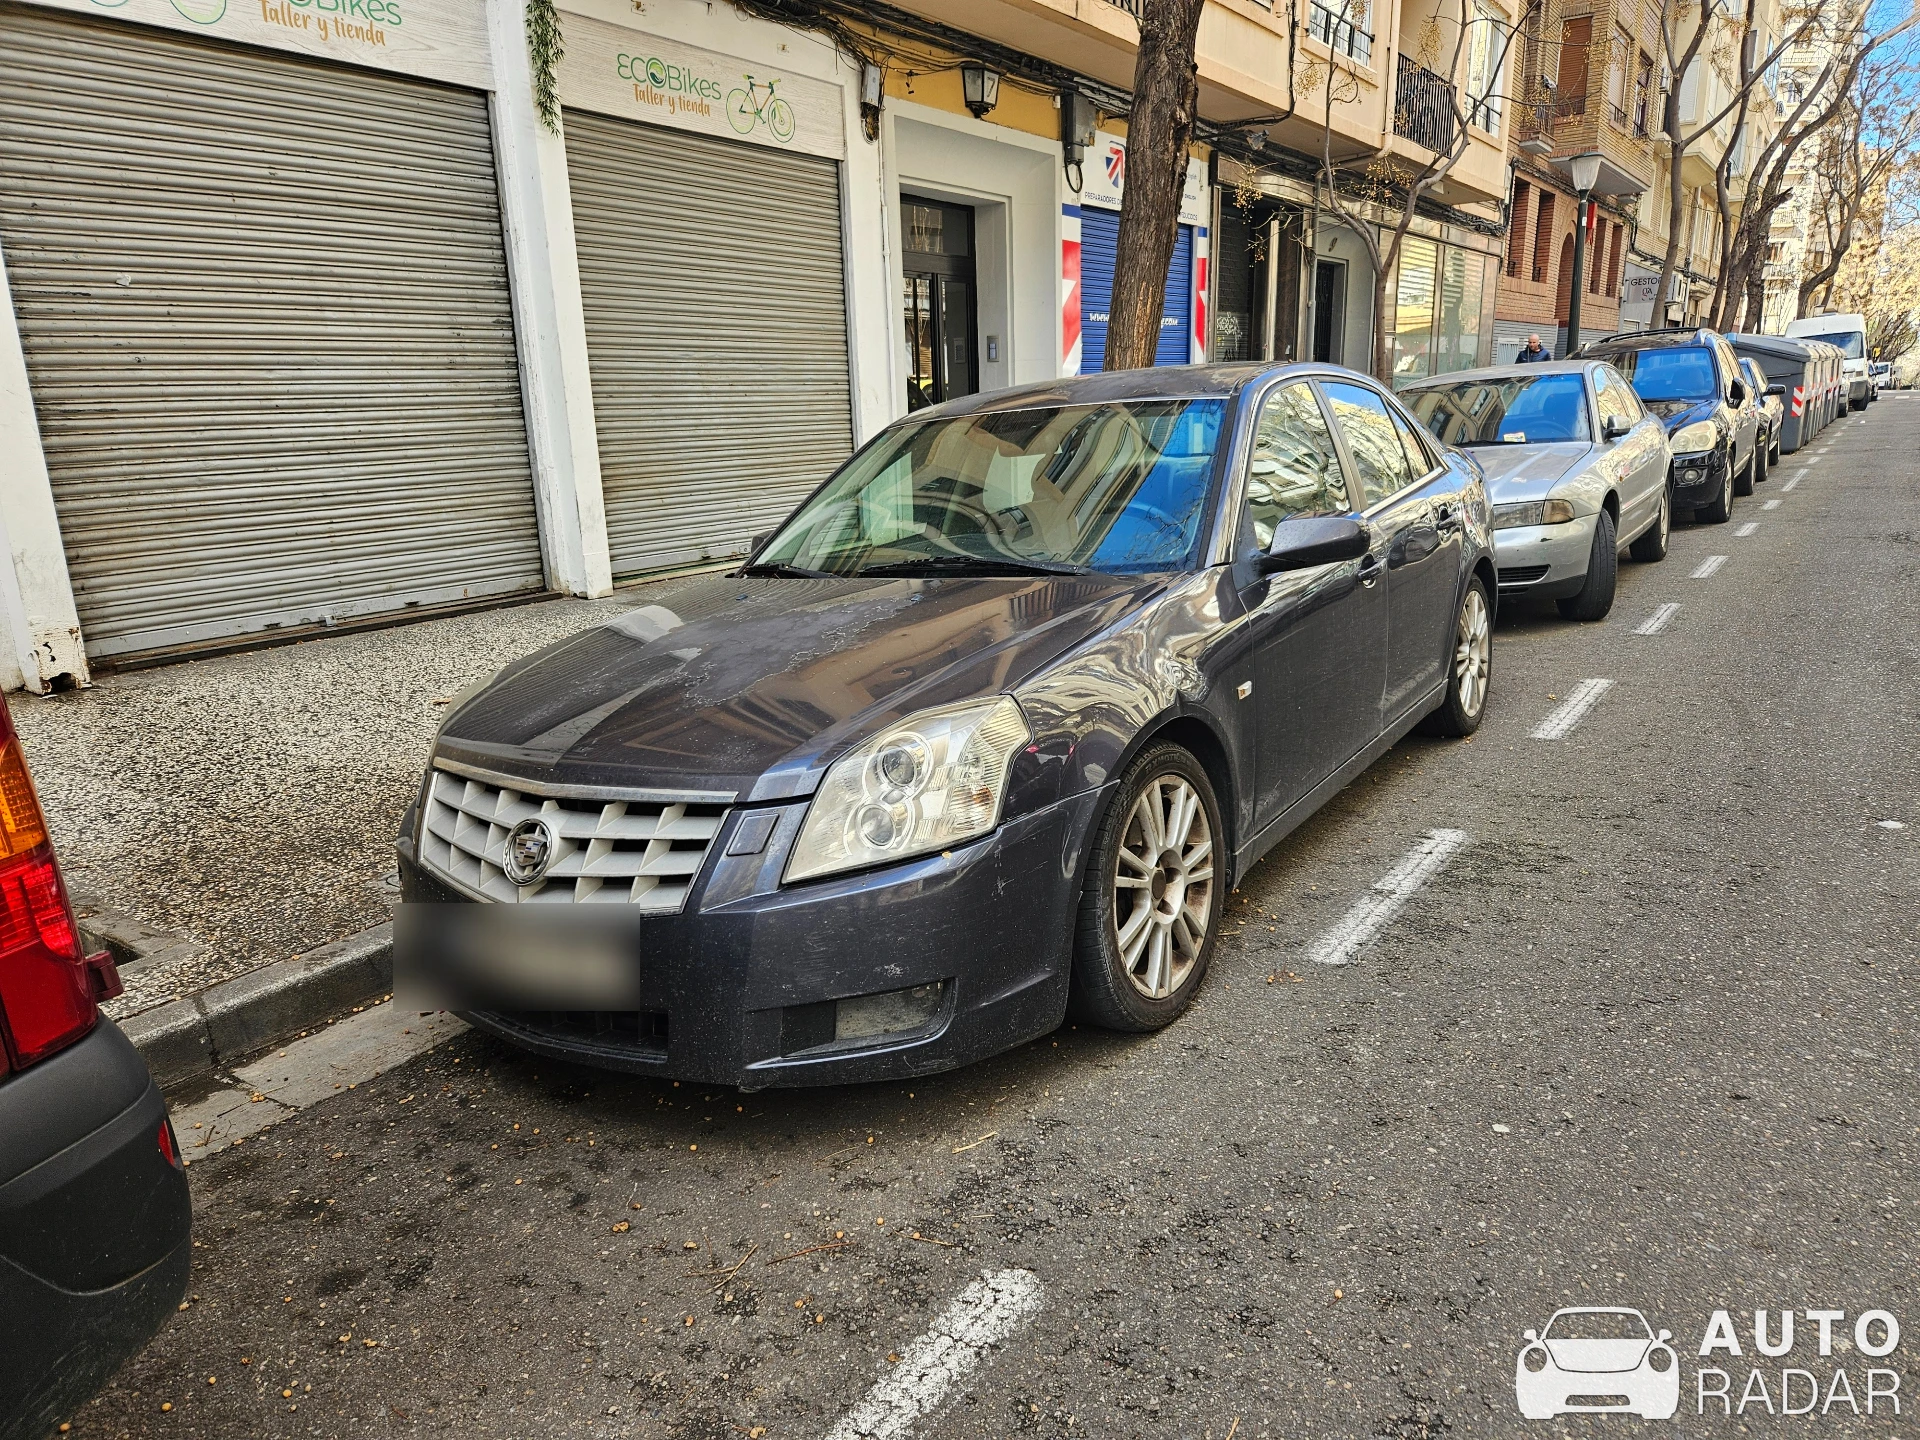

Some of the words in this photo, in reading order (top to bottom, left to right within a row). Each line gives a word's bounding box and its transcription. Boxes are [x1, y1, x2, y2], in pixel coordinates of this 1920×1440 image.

[258, 0, 311, 30] Taller
[317, 17, 329, 42] y
[333, 17, 386, 47] tienda
[617, 53, 722, 100] ECOBikes
[987, 76, 996, 98] 7
[633, 83, 664, 107] Taller
[668, 95, 676, 115] y
[678, 94, 711, 117] tienda
